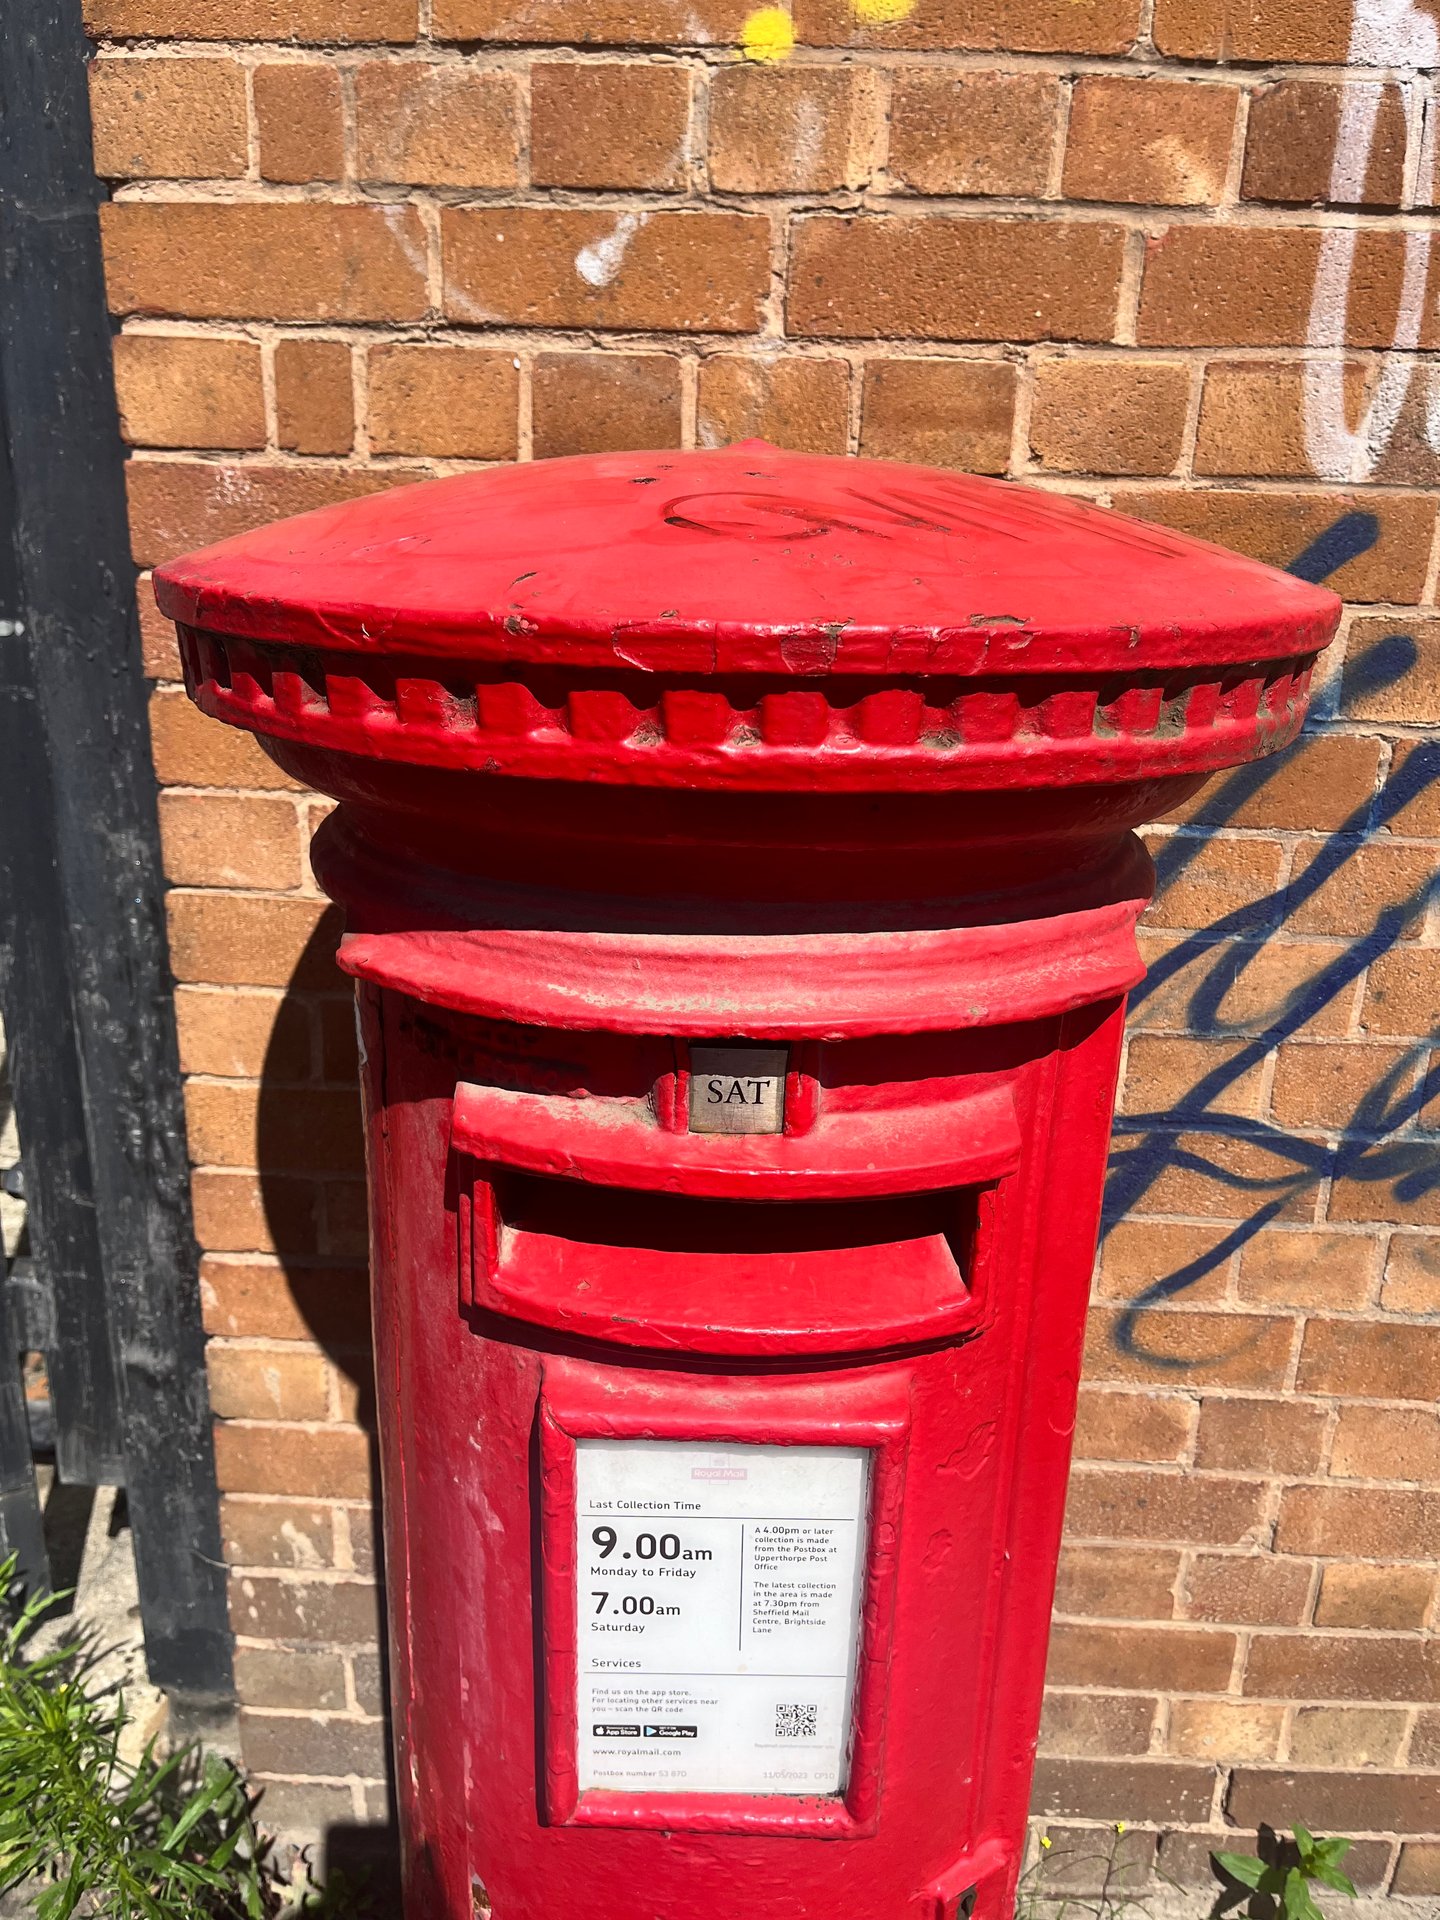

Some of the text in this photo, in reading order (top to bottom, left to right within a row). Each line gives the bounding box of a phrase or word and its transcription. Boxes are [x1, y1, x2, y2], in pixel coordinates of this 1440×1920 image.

[707, 1080, 770, 1104] SAT
[694, 1470, 745, 1479] Royal Mail
[589, 1500, 701, 1510] Last Collection Time
[763, 1526, 799, 1534] 4.00pm
[592, 1526, 712, 1560] 9.00am
[591, 1567, 638, 1578] Monday
[659, 1568, 696, 1578] Friday
[591, 1592, 680, 1615] 7.00am
[592, 1623, 645, 1633] Saturday
[592, 1658, 641, 1667] Services
